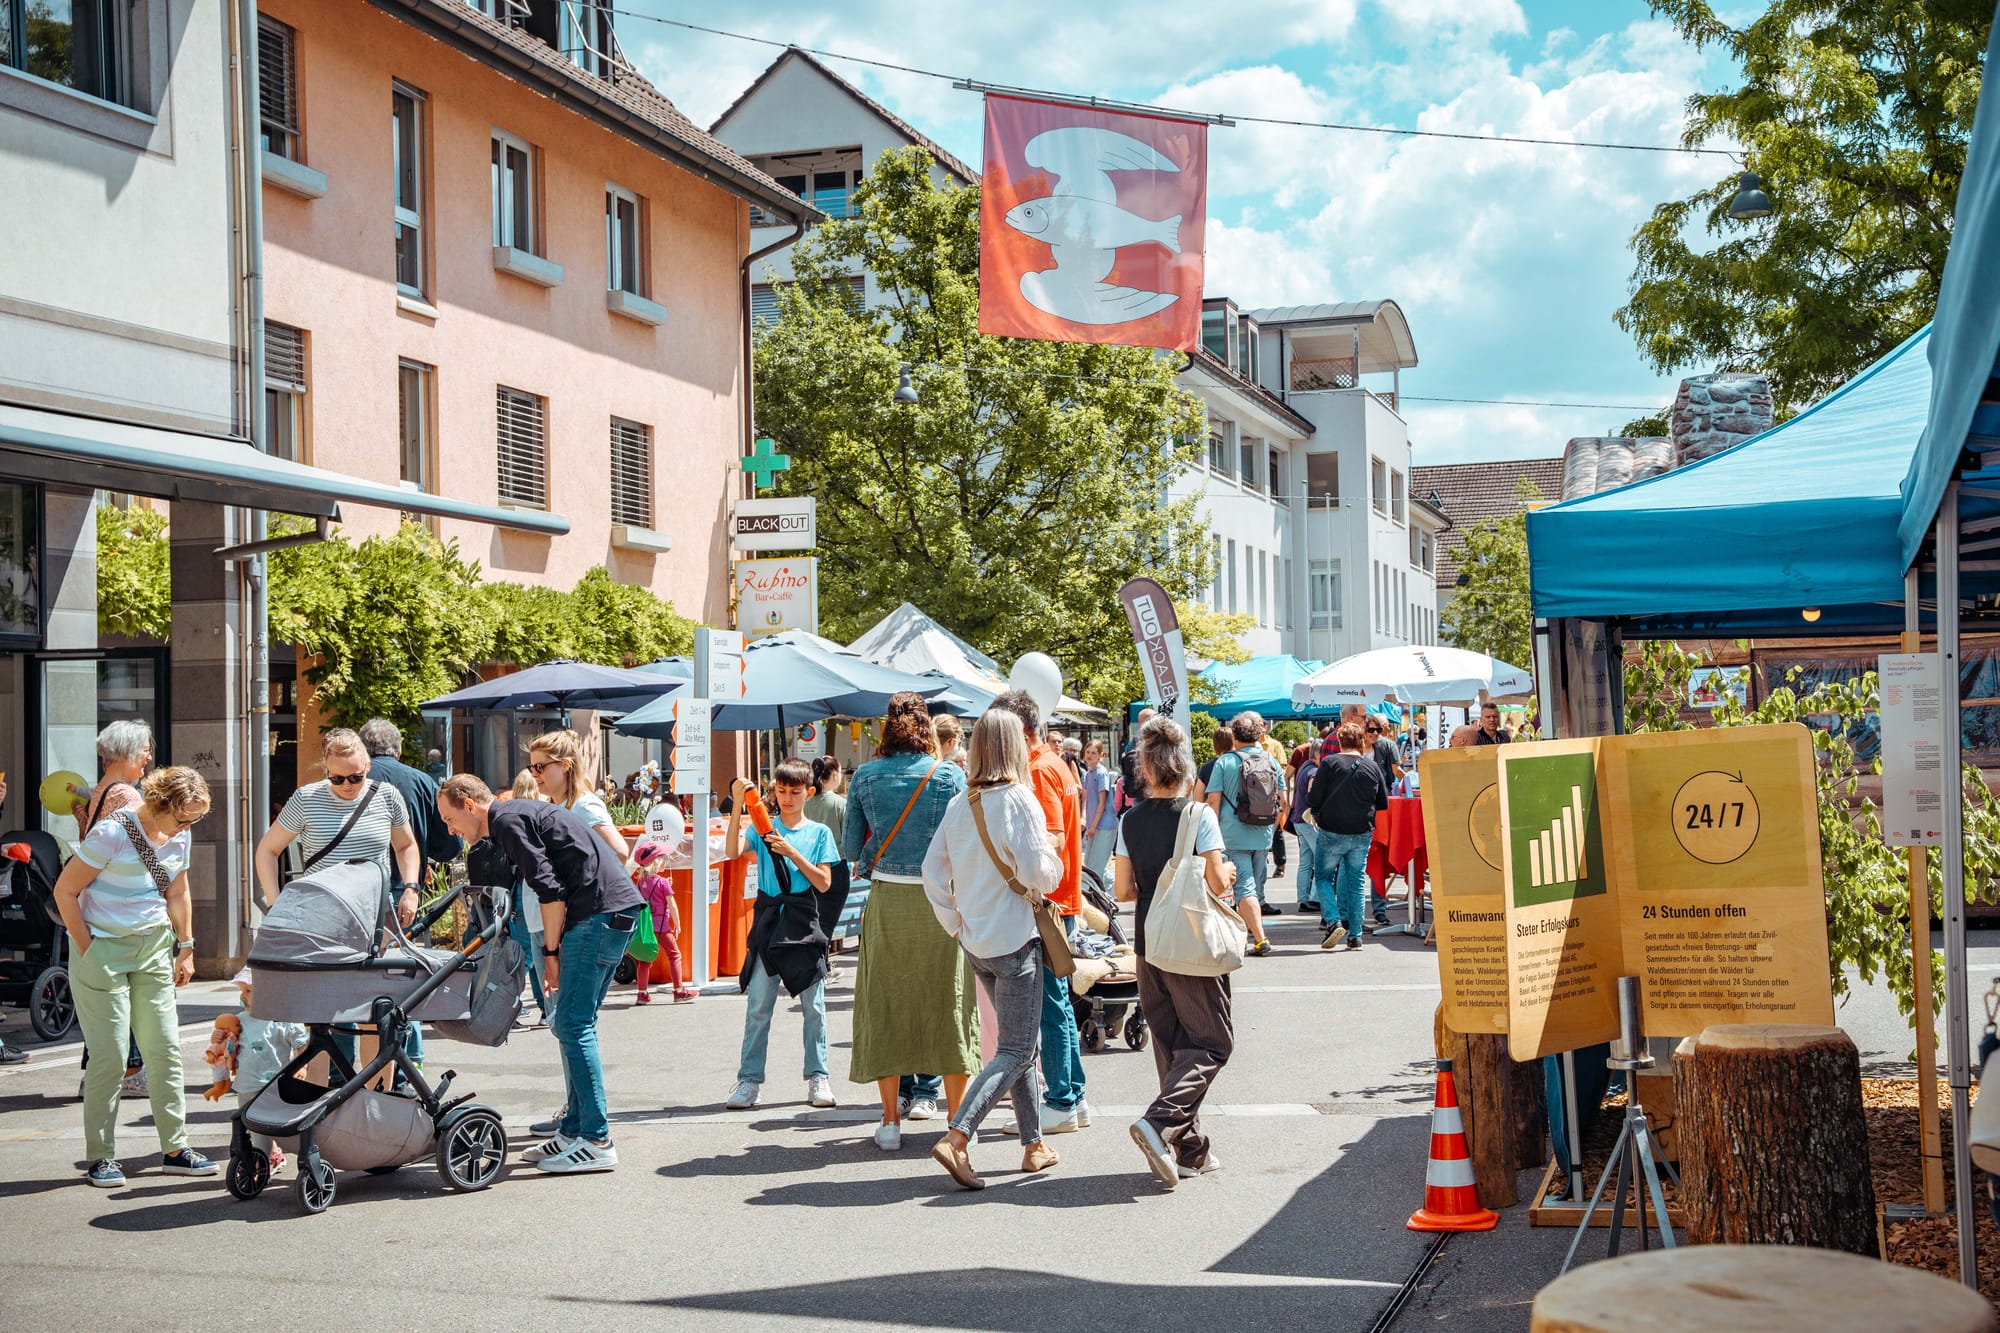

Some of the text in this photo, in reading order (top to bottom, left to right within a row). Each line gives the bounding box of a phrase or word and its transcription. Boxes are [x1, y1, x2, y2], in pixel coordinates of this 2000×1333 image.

[738, 518, 806, 531] BLACKOUT
[739, 568, 807, 593] Rubino
[690, 706, 698, 715] Zelt
[685, 724, 693, 733] Zelt
[1643, 904, 1746, 918] 24 Stunden offen
[1517, 916, 1580, 937] Steter Erfolgskurs
[1700, 931, 1722, 939] Jahren
[1724, 931, 1746, 939] erlaubt
[1748, 931, 1760, 939] das
[1762, 930, 1777, 938] Zivil-
[1646, 943, 1680, 952] gesetzbuch
[1648, 978, 1658, 986] die
[1660, 977, 1701, 986] Öffentlichkeit
[1703, 978, 1730, 986] während
[1742, 978, 1770, 986] Stunden
[1663, 990, 1686, 999] pflegen
[1727, 990, 1749, 999] Tragen
[1650, 1002, 1668, 1010] Sorge
